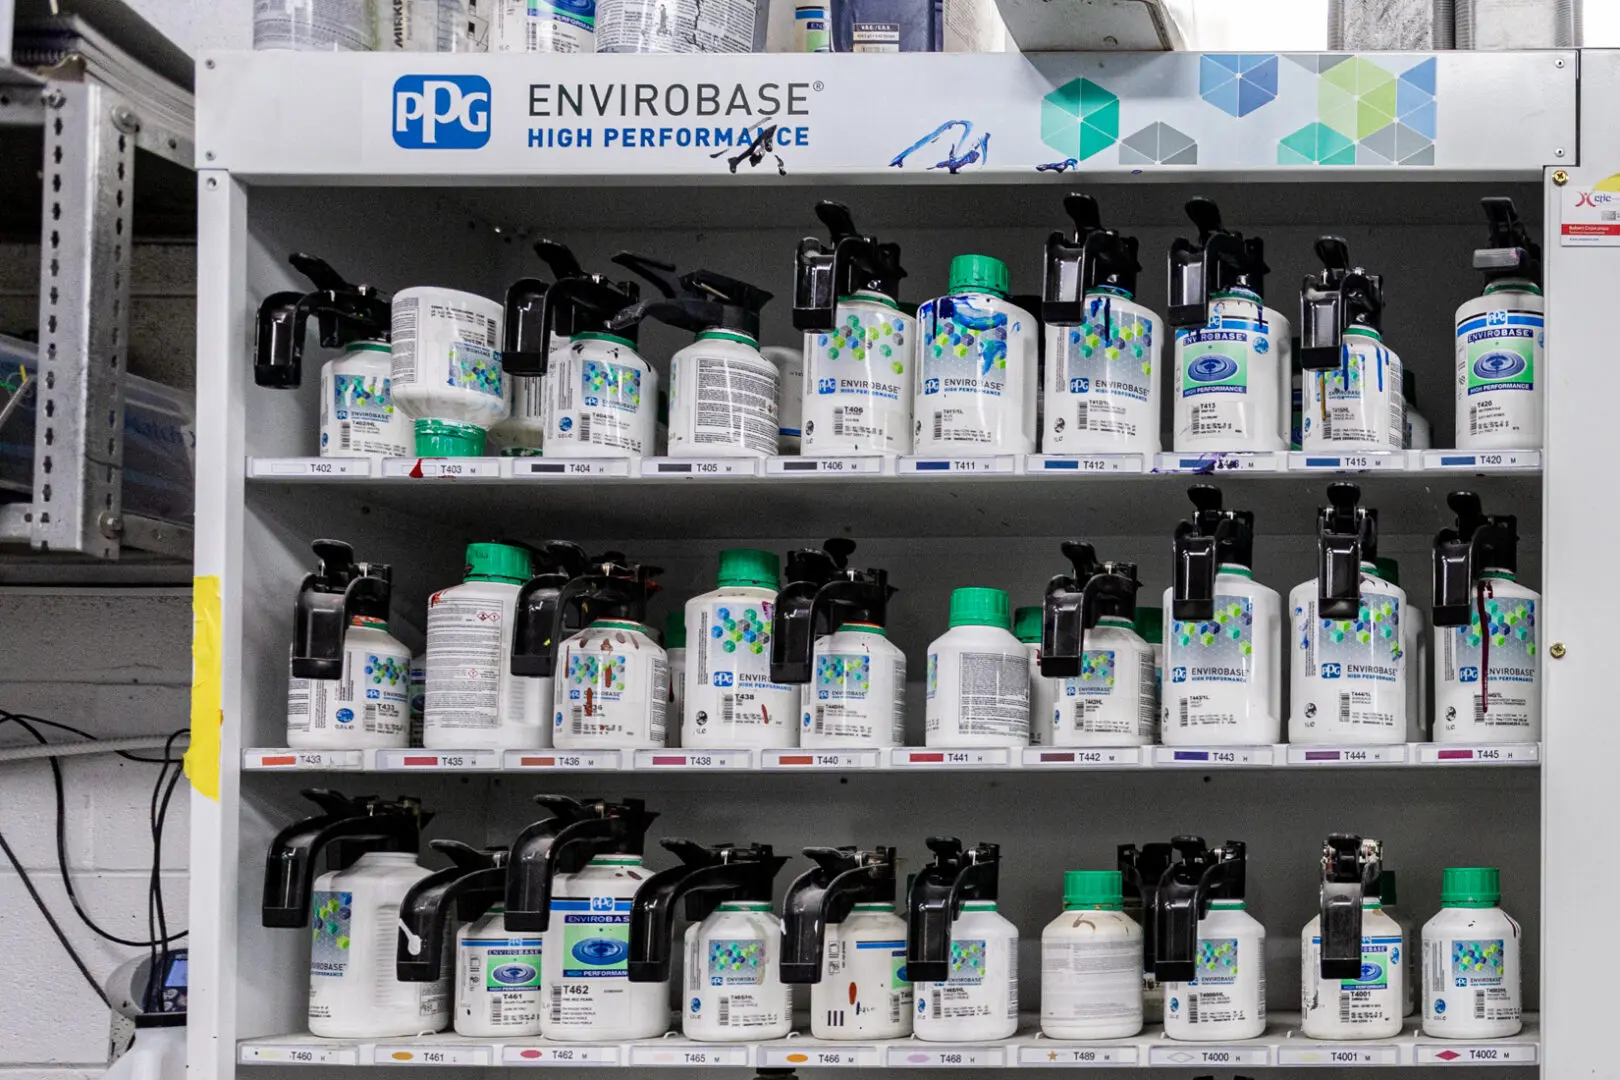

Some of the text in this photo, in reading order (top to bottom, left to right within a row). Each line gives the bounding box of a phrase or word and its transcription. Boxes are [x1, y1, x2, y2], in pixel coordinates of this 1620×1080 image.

[395, 79, 488, 144] PPG
[528, 128, 592, 147] HIGH
[1344, 457, 1367, 467] T415
[1480, 455, 1502, 464] T420
[311, 464, 331, 472] T402
[441, 465, 462, 474] T403
[569, 464, 591, 473] T404
[696, 463, 718, 472] T405
[822, 461, 843, 470] T406
[954, 461, 976, 470] T411
[1083, 461, 1105, 469] T412
[947, 753, 968, 762] T441
[1079, 753, 1101, 761] T442
[1212, 752, 1234, 762] T443
[1344, 751, 1366, 760] T444
[1477, 750, 1499, 759] T445
[300, 755, 321, 766] T433
[442, 757, 463, 766] T435
[559, 757, 580, 766] T436
[690, 757, 711, 765] T438
[817, 756, 838, 765] T440
[563, 985, 589, 995] T462
[290, 1051, 312, 1061] T460
[424, 1052, 444, 1062] T461
[552, 1050, 573, 1059] T462
[685, 1053, 705, 1063] T465
[818, 1054, 840, 1063] T466
[940, 1054, 961, 1063] T468
[1074, 1051, 1095, 1061] T489
[1202, 1052, 1229, 1061] T4000
[1331, 1052, 1357, 1061] T4001
[1469, 1050, 1497, 1059] T4002
